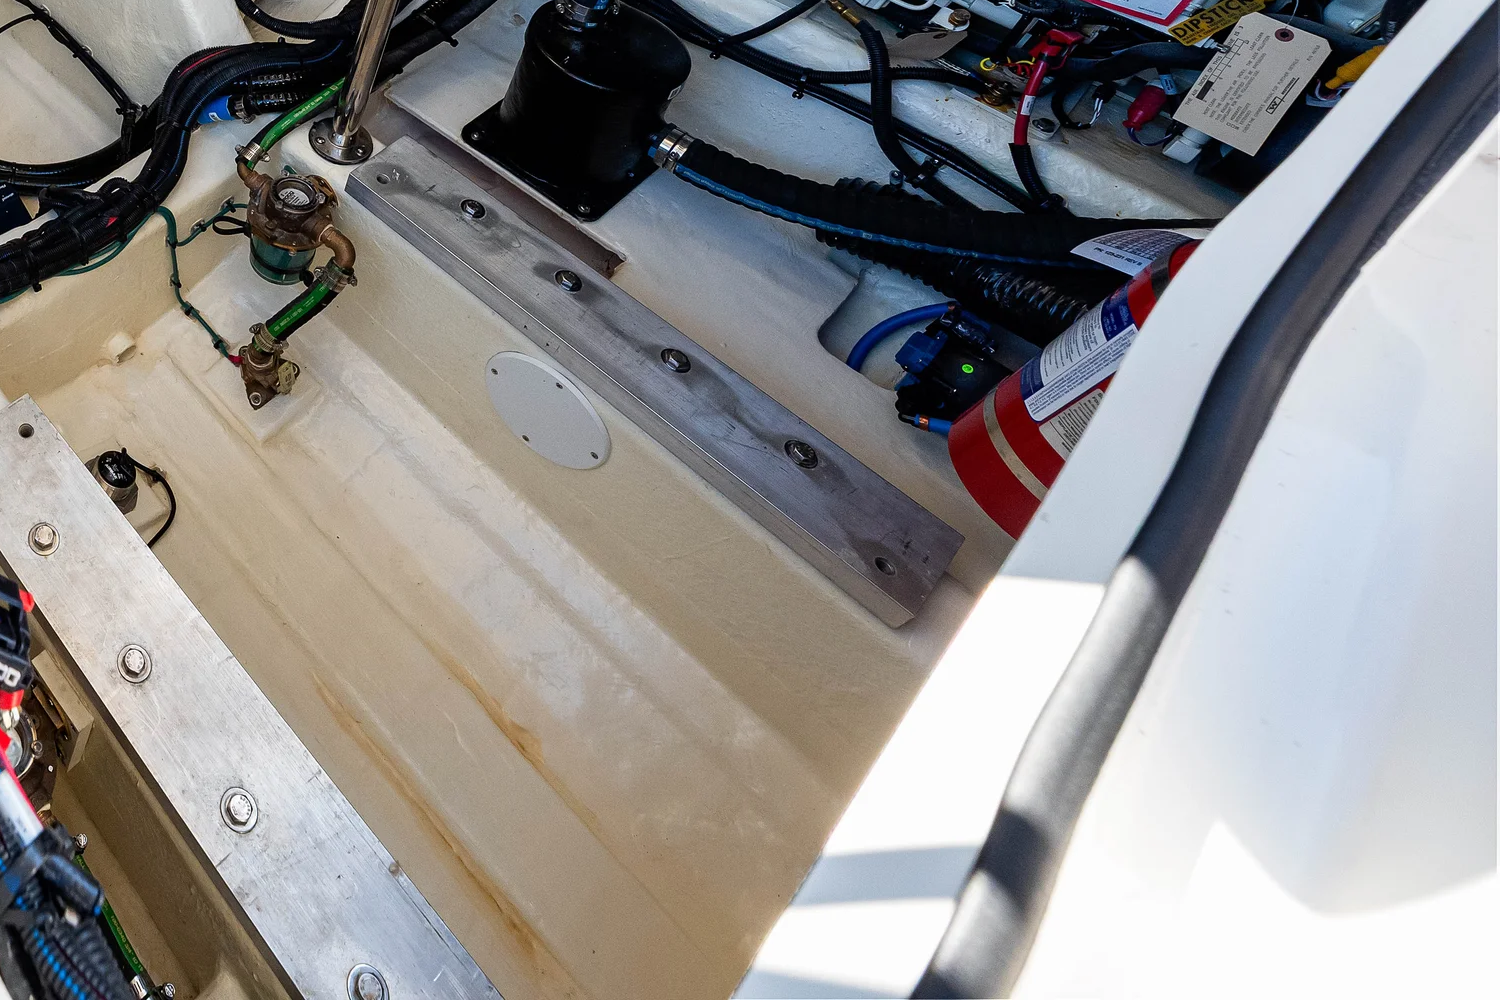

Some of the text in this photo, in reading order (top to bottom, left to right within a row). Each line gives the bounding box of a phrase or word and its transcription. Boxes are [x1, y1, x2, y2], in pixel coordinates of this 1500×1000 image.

[1184, 97, 1193, 106] THE
[1197, 73, 1209, 87] INDEX
[1211, 54, 1222, 65] THIS
